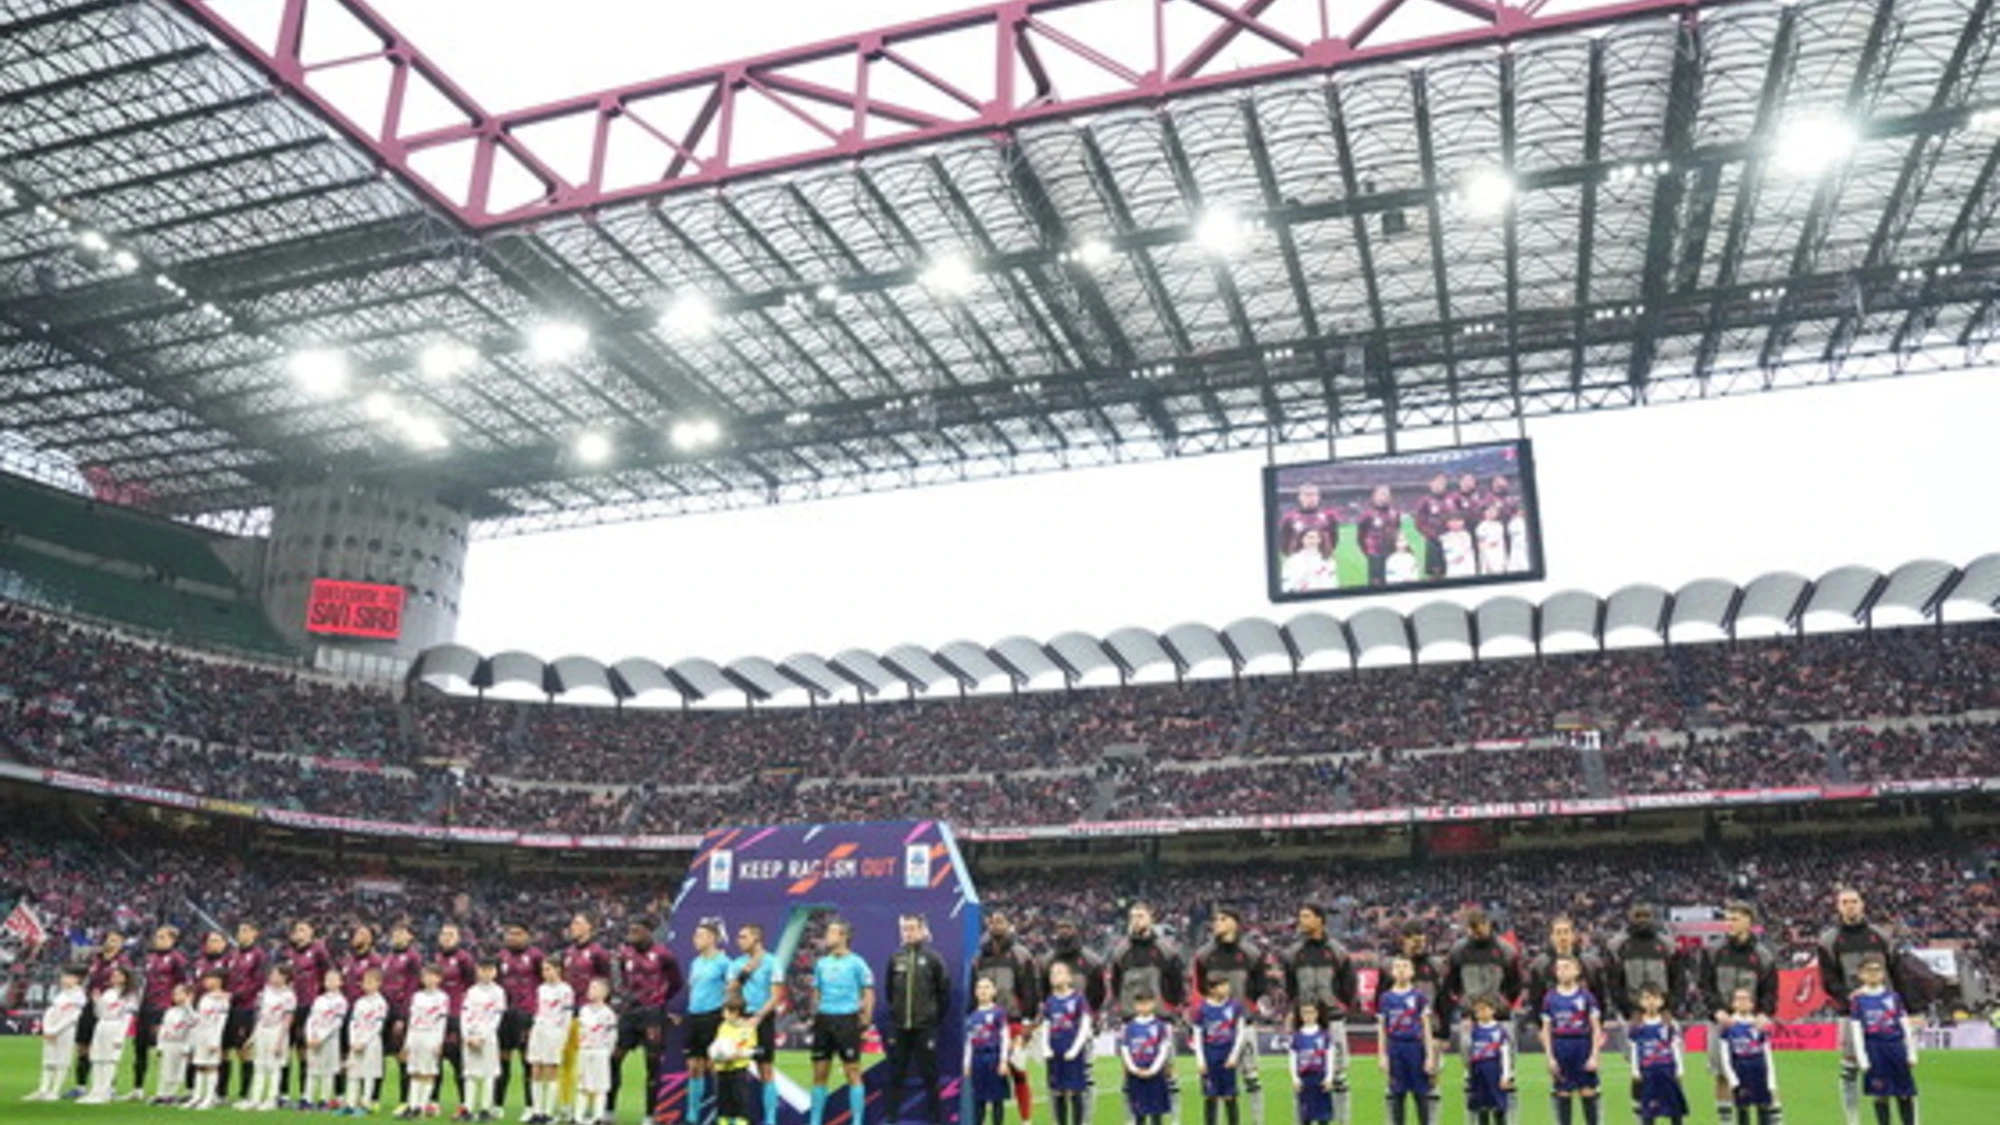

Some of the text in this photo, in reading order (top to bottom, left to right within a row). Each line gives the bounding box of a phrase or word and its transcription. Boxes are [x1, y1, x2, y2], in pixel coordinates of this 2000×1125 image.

[311, 602, 398, 632] SAN SIRO
[739, 857, 896, 879] KEEP RACISM OUT
